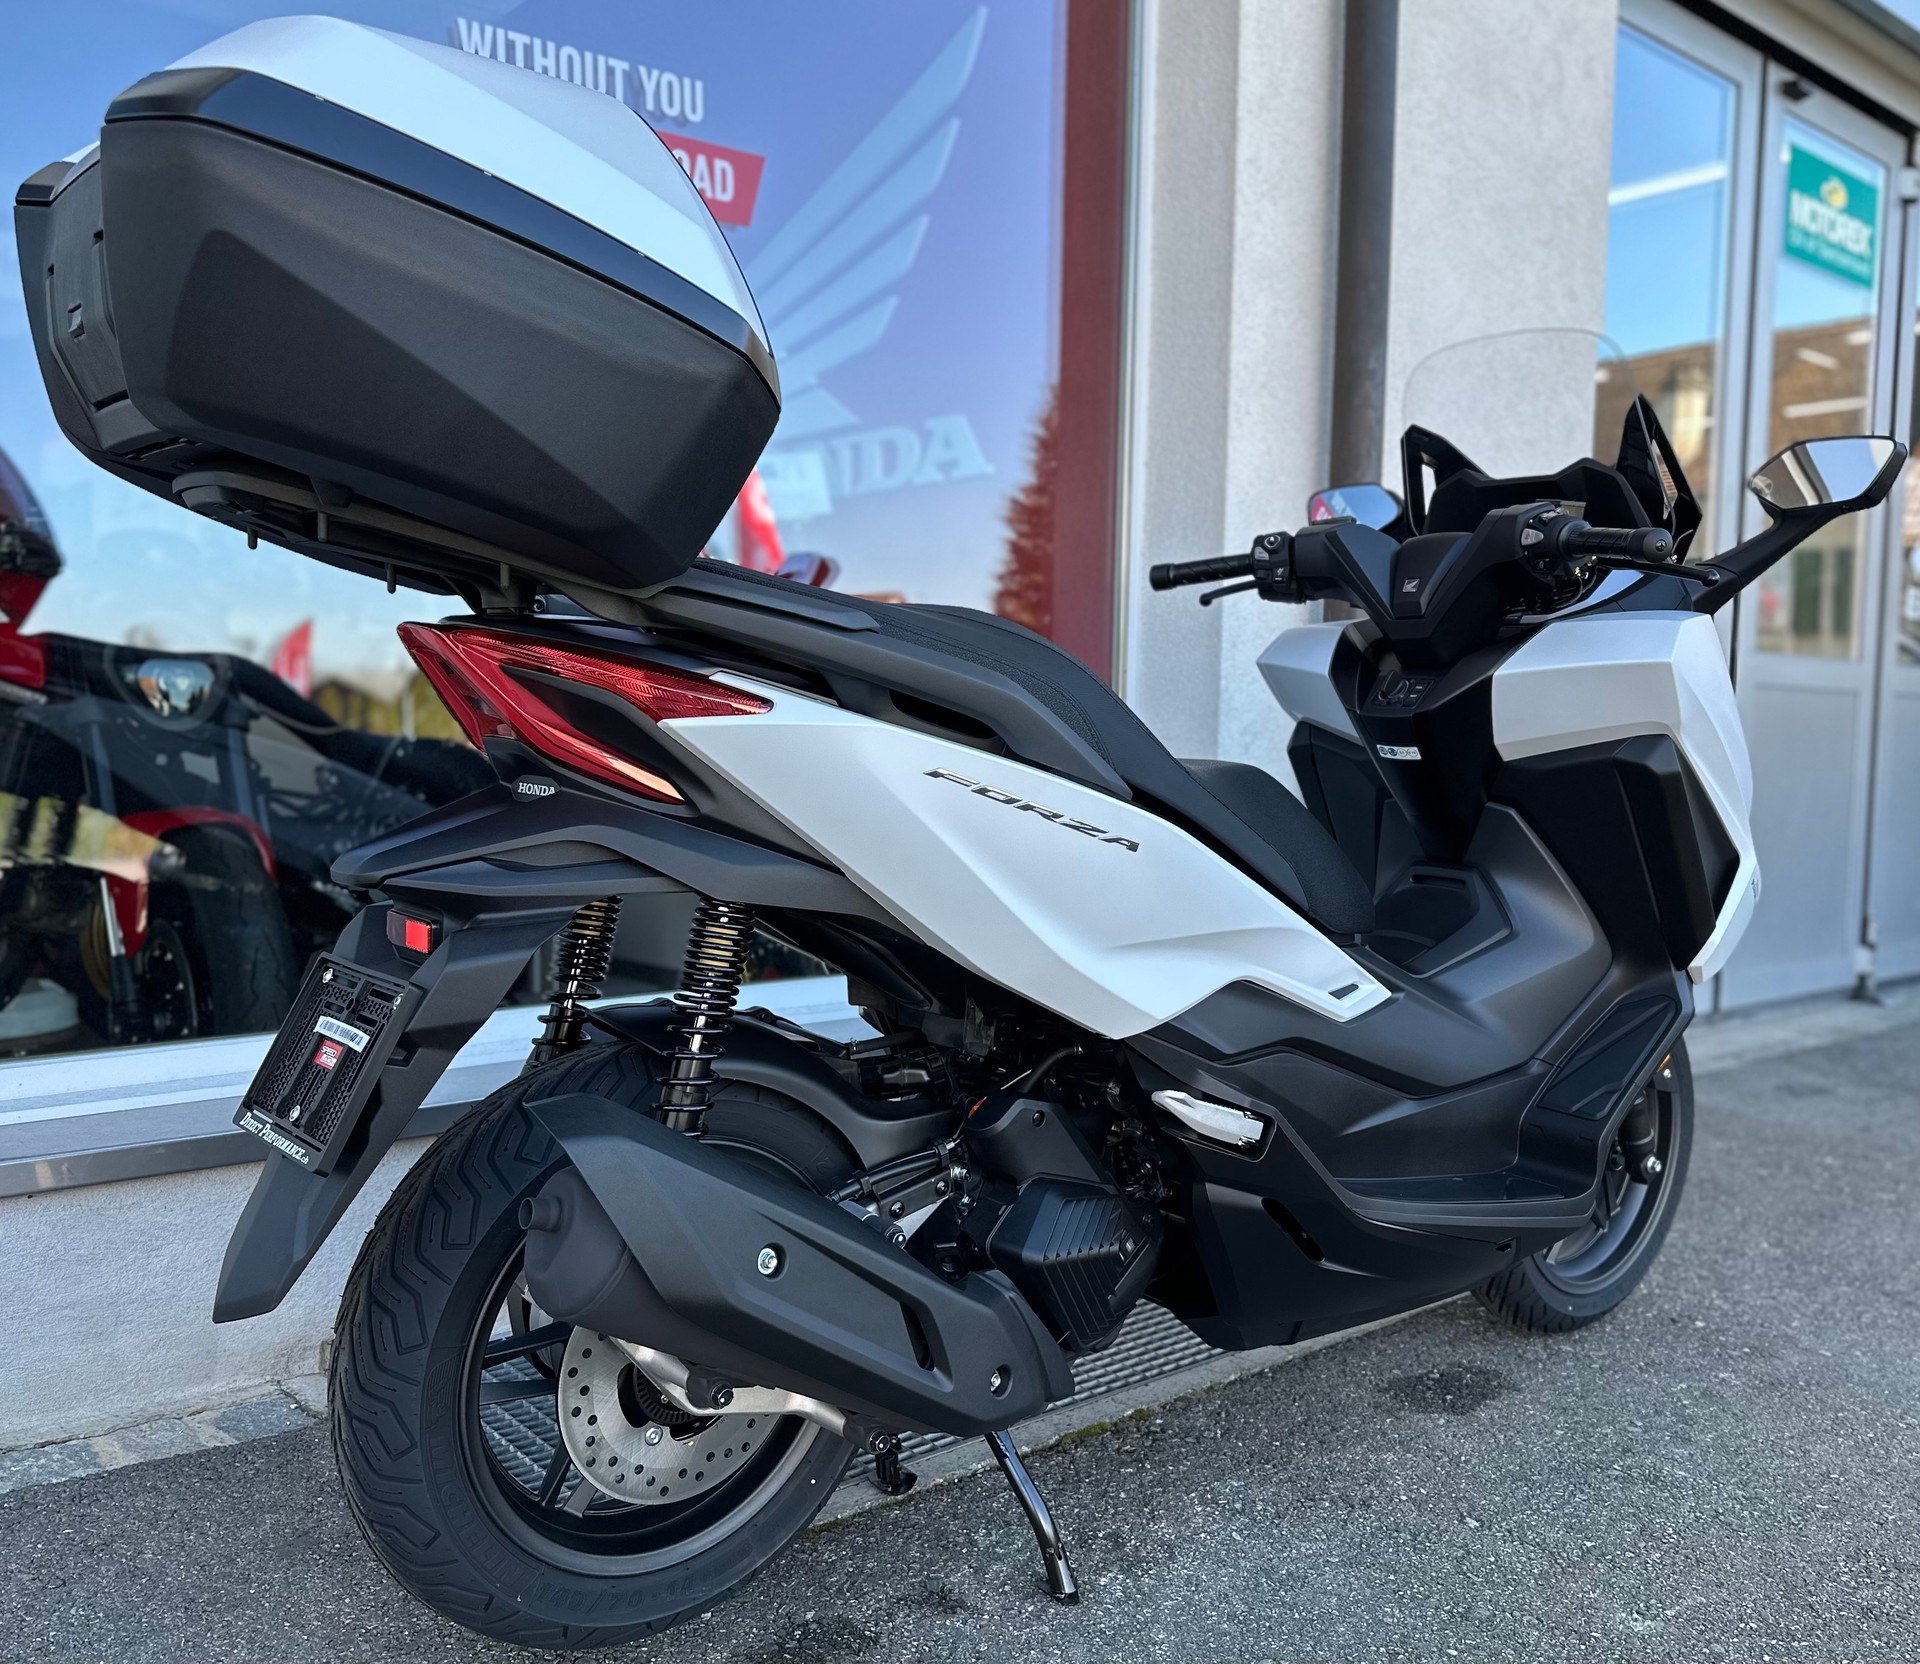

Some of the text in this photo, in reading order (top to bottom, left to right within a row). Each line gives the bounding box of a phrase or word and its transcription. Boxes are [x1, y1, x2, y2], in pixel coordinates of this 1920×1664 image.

[457, 17, 704, 123] WITHOUT YOU
[517, 782, 556, 796] HONDA
[922, 767, 1141, 853] FORZA
